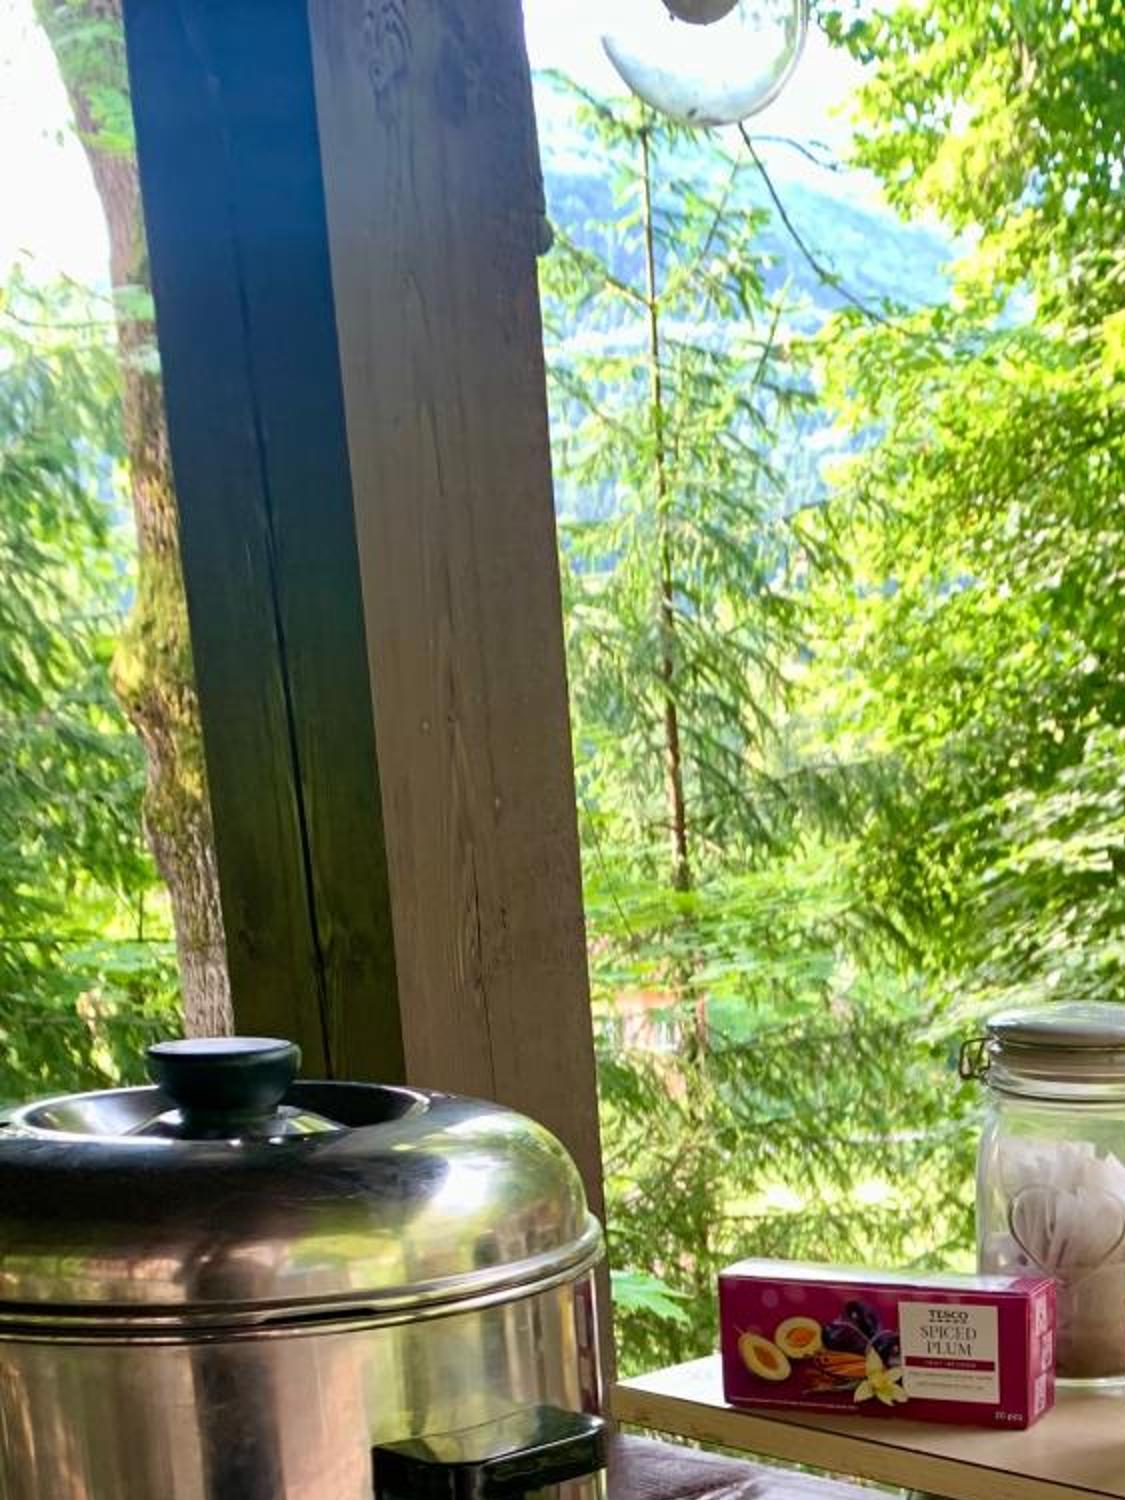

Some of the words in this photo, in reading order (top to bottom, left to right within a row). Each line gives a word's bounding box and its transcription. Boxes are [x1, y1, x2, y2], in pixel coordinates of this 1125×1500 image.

[928, 1309, 969, 1321] TESCO
[920, 1325, 977, 1341] SPICED
[927, 1341, 972, 1357] PLUM
